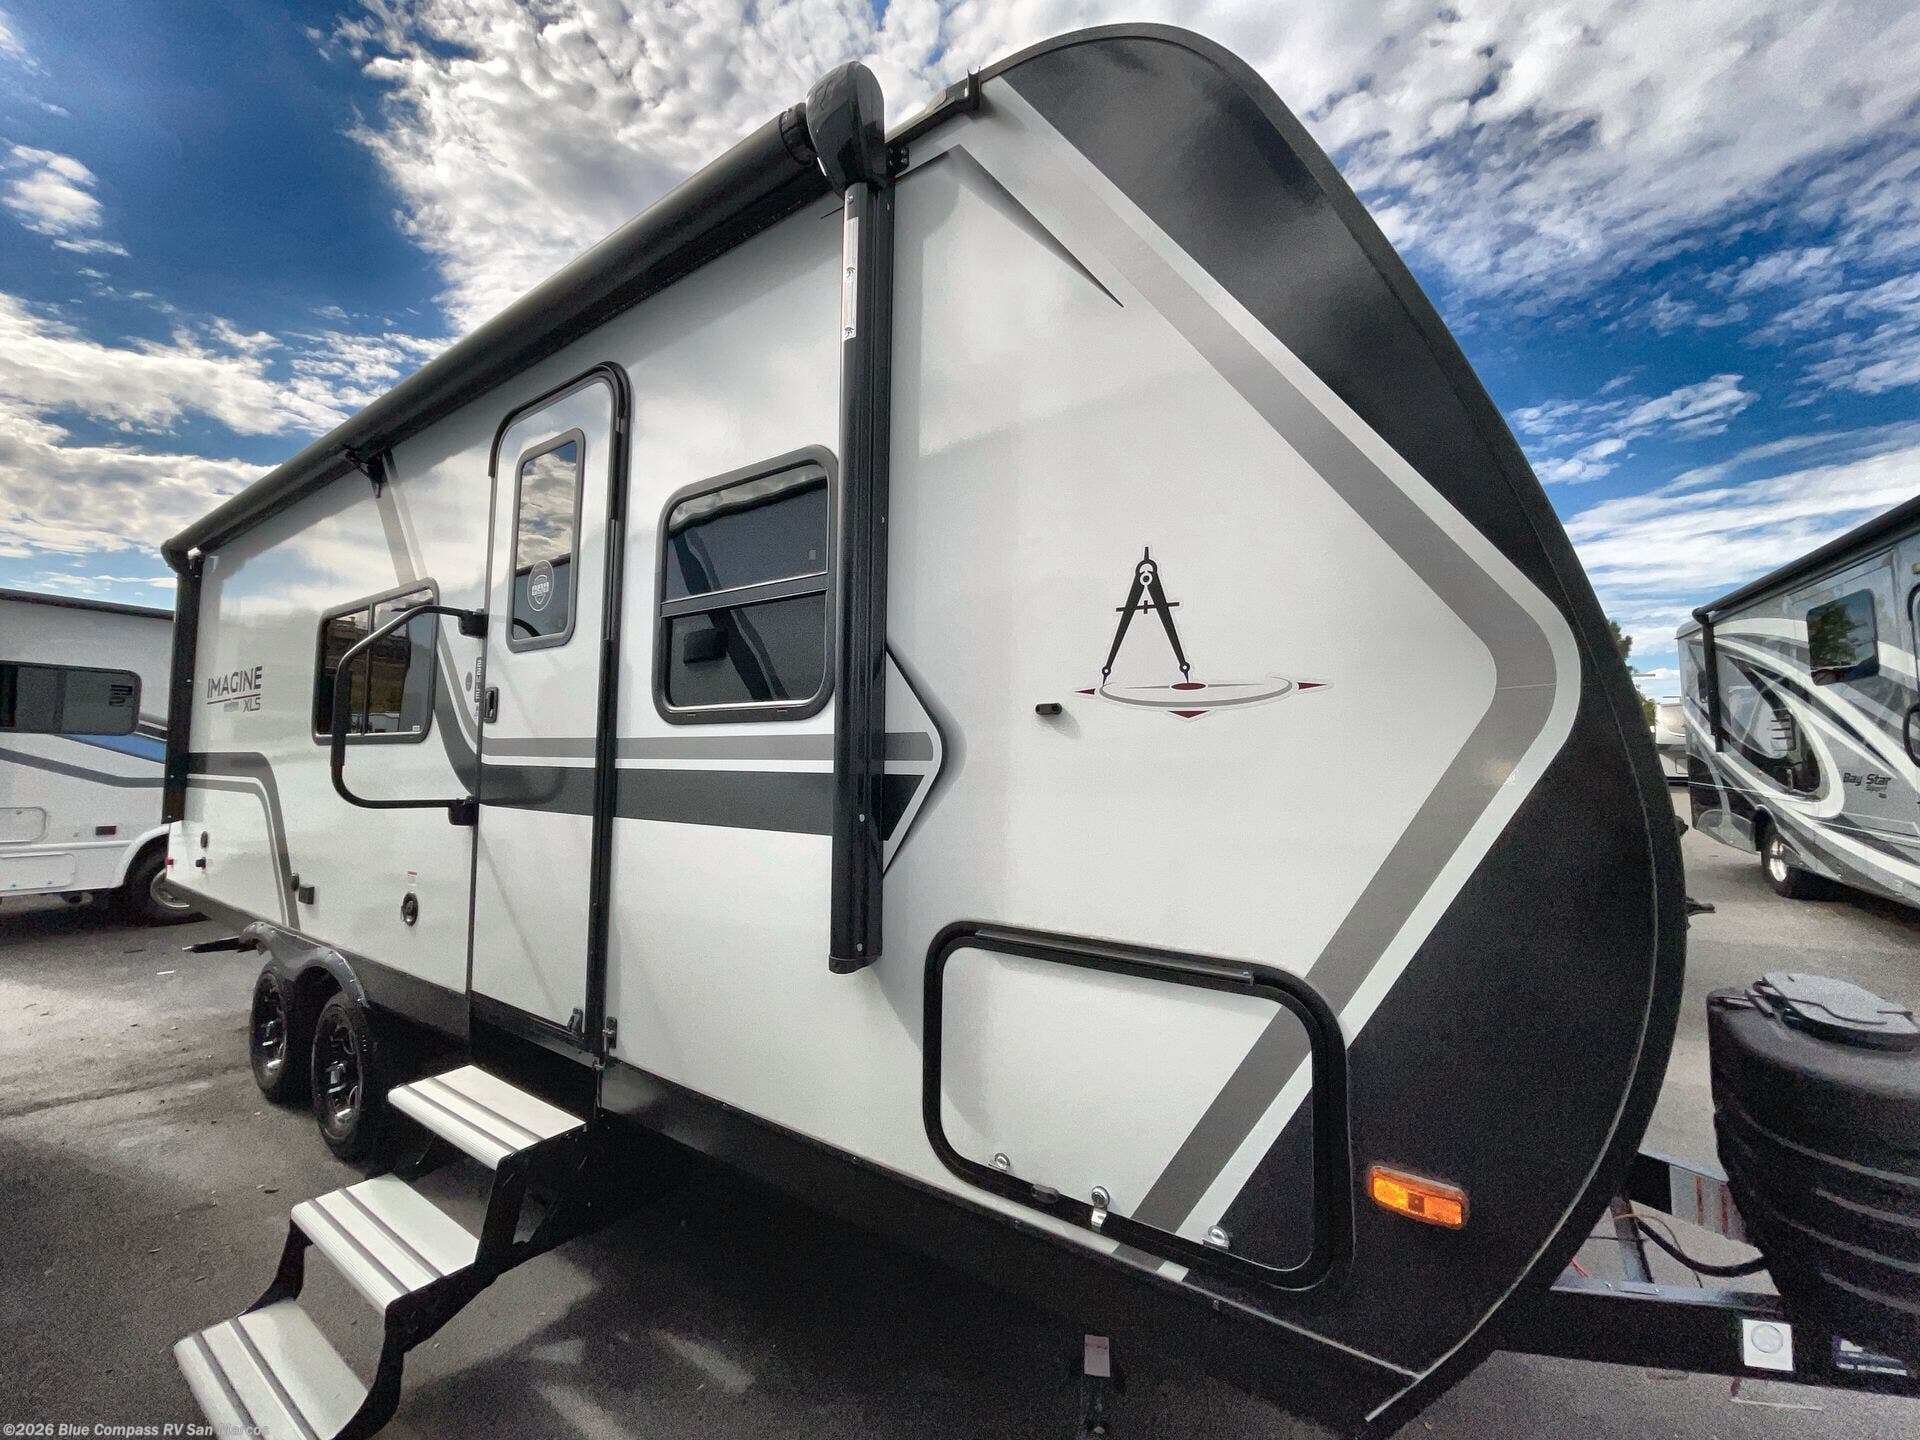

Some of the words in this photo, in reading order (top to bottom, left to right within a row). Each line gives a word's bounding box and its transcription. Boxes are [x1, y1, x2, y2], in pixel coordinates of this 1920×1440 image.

[207, 666, 262, 698] IMAGINE
[243, 697, 261, 712] XLS
[1843, 772, 1862, 786] Bay
[1866, 773, 1891, 785] Star
